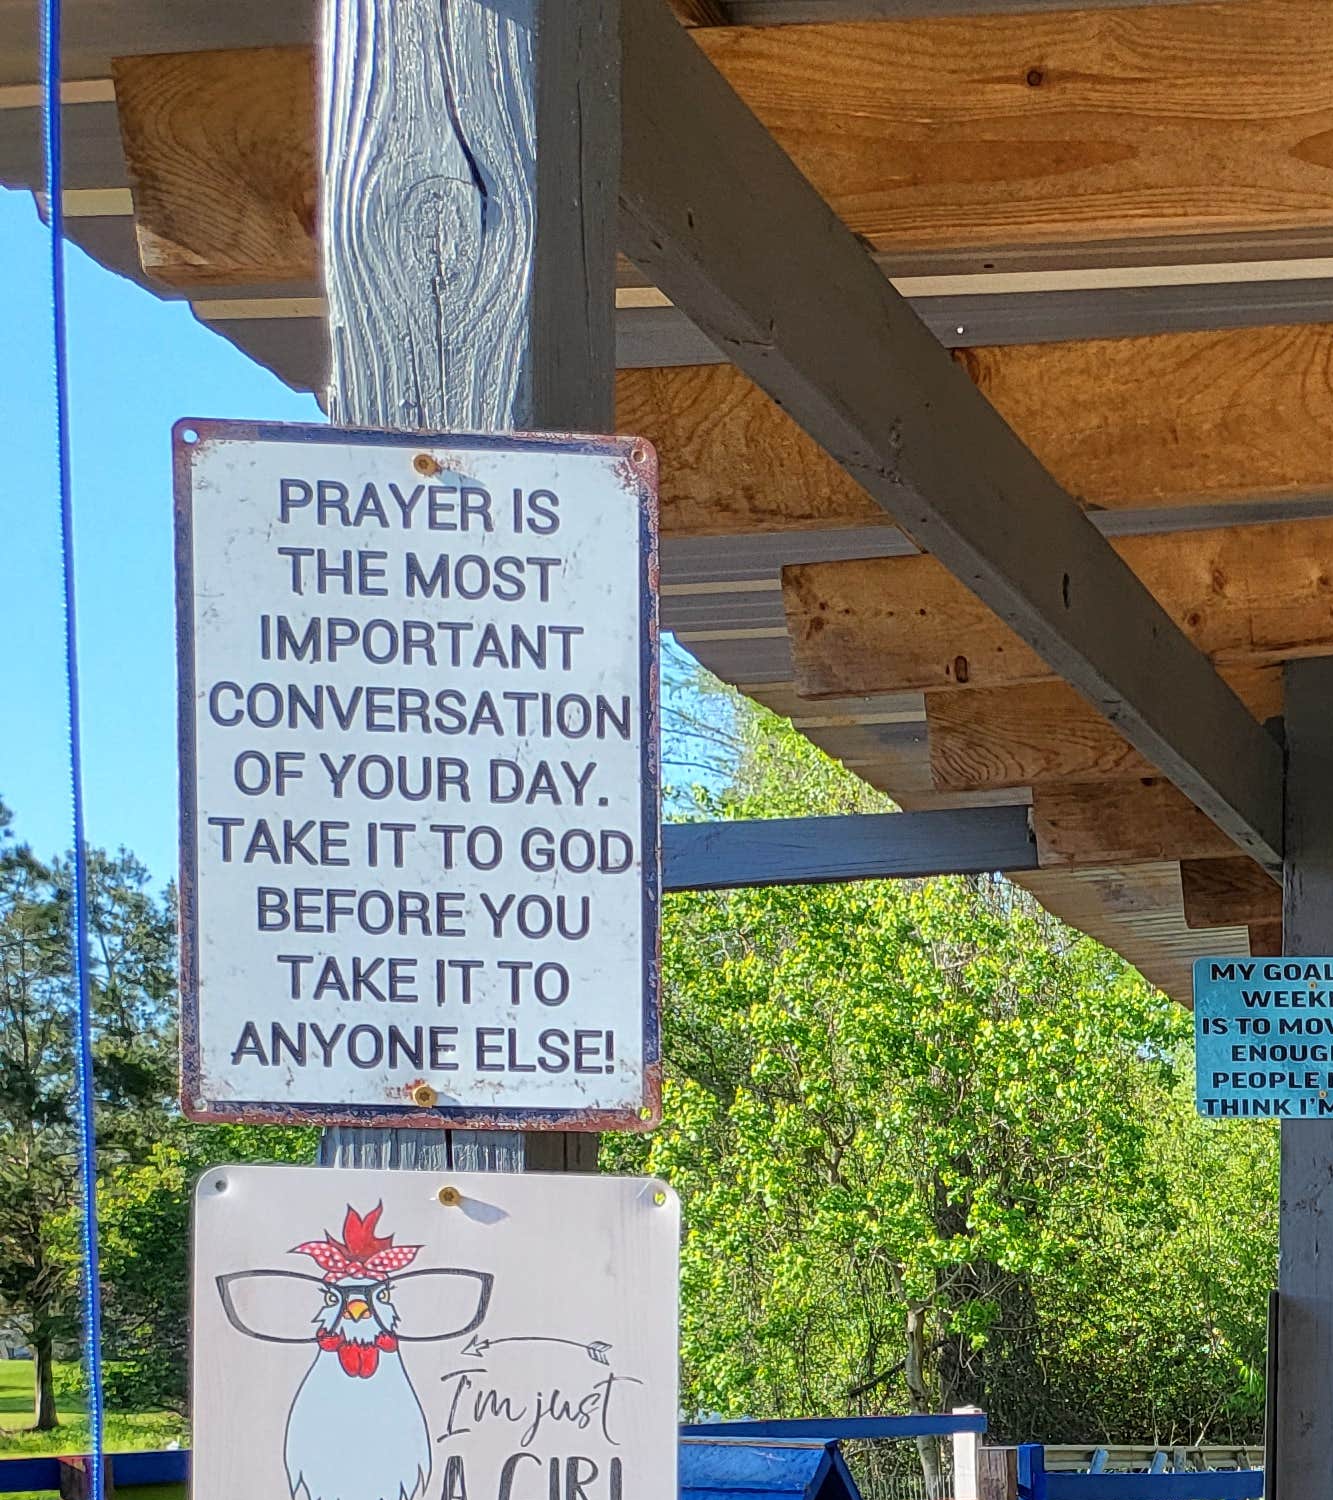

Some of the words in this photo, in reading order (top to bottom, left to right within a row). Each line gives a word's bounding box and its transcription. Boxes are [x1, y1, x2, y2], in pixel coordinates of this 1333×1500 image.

[279, 479, 494, 533] PRAYER
[511, 489, 560, 535] IS
[278, 546, 389, 596] THE
[405, 551, 561, 602] MOST
[260, 614, 584, 671] IMPORTANT
[208, 681, 632, 740] CONVERSATION
[233, 750, 306, 796] OF
[320, 753, 470, 803] YOUR
[489, 759, 609, 807] DAY.
[207, 817, 350, 866] TAKE
[367, 822, 414, 867] IT
[430, 824, 504, 872] TO
[520, 827, 634, 874] GOD
[257, 887, 466, 936] BEFORE
[480, 893, 590, 940] YOU
[277, 954, 419, 1002] TAKE
[436, 958, 485, 1007] IT
[498, 960, 571, 1006] TO
[1211, 963, 1256, 981] MY
[231, 1022, 459, 1071] ANYONE
[475, 1027, 615, 1075] ELSE!
[1203, 1018, 1228, 1035] IS
[1235, 1018, 1270, 1035] TO
[1203, 1099, 1290, 1116] THINK
[1212, 1072, 1320, 1089] PEOPLE
[522, 1373, 643, 1446] just
